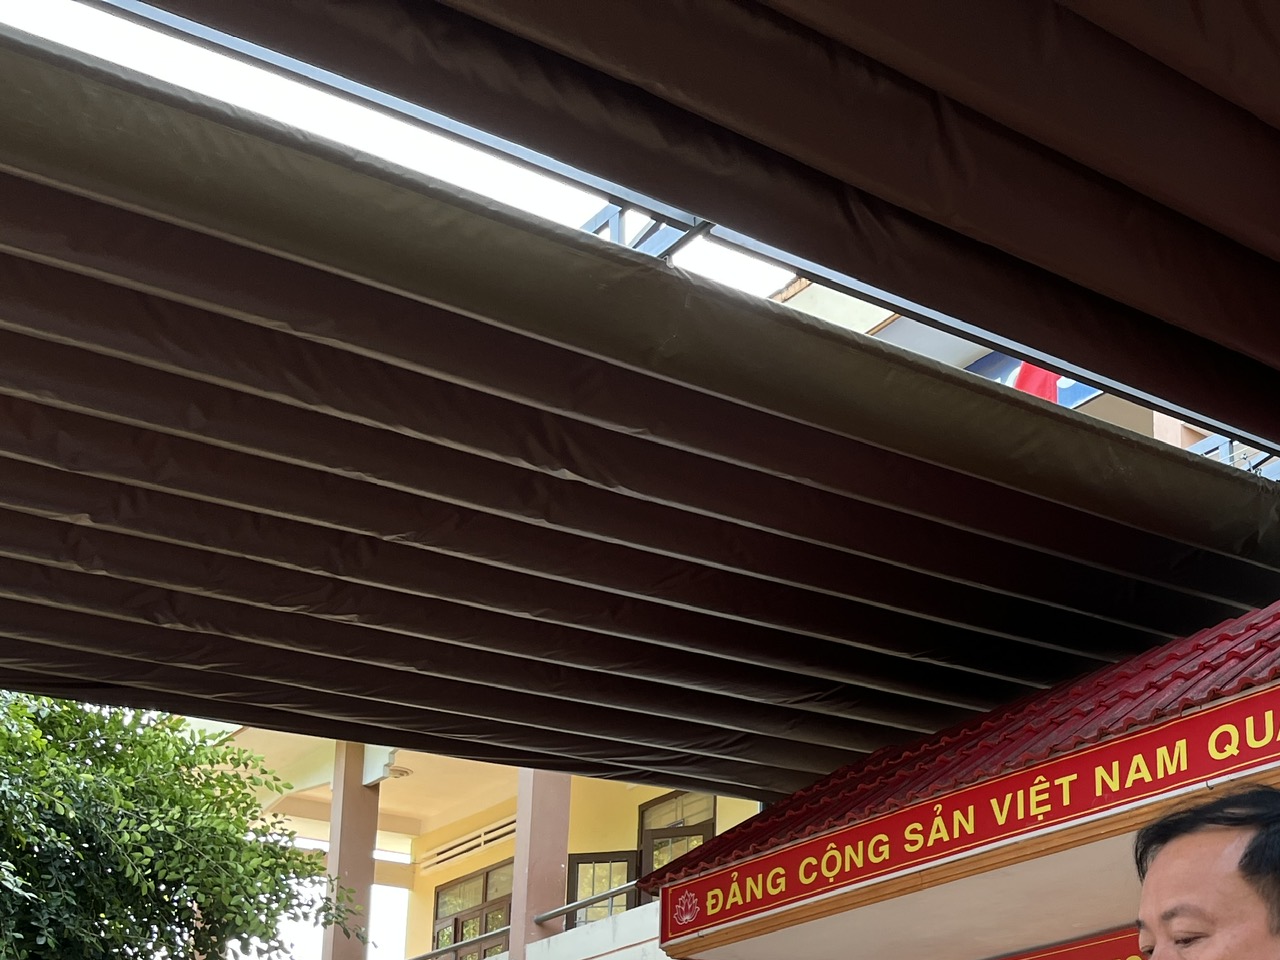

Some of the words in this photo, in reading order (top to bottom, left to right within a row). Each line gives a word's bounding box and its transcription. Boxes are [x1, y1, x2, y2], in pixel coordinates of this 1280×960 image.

[705, 871, 787, 916] ĐẢNG
[798, 833, 891, 883] CỘNG
[904, 805, 977, 854] SẢN
[990, 775, 1079, 828] VIỆT
[1094, 739, 1188, 796] NAM
